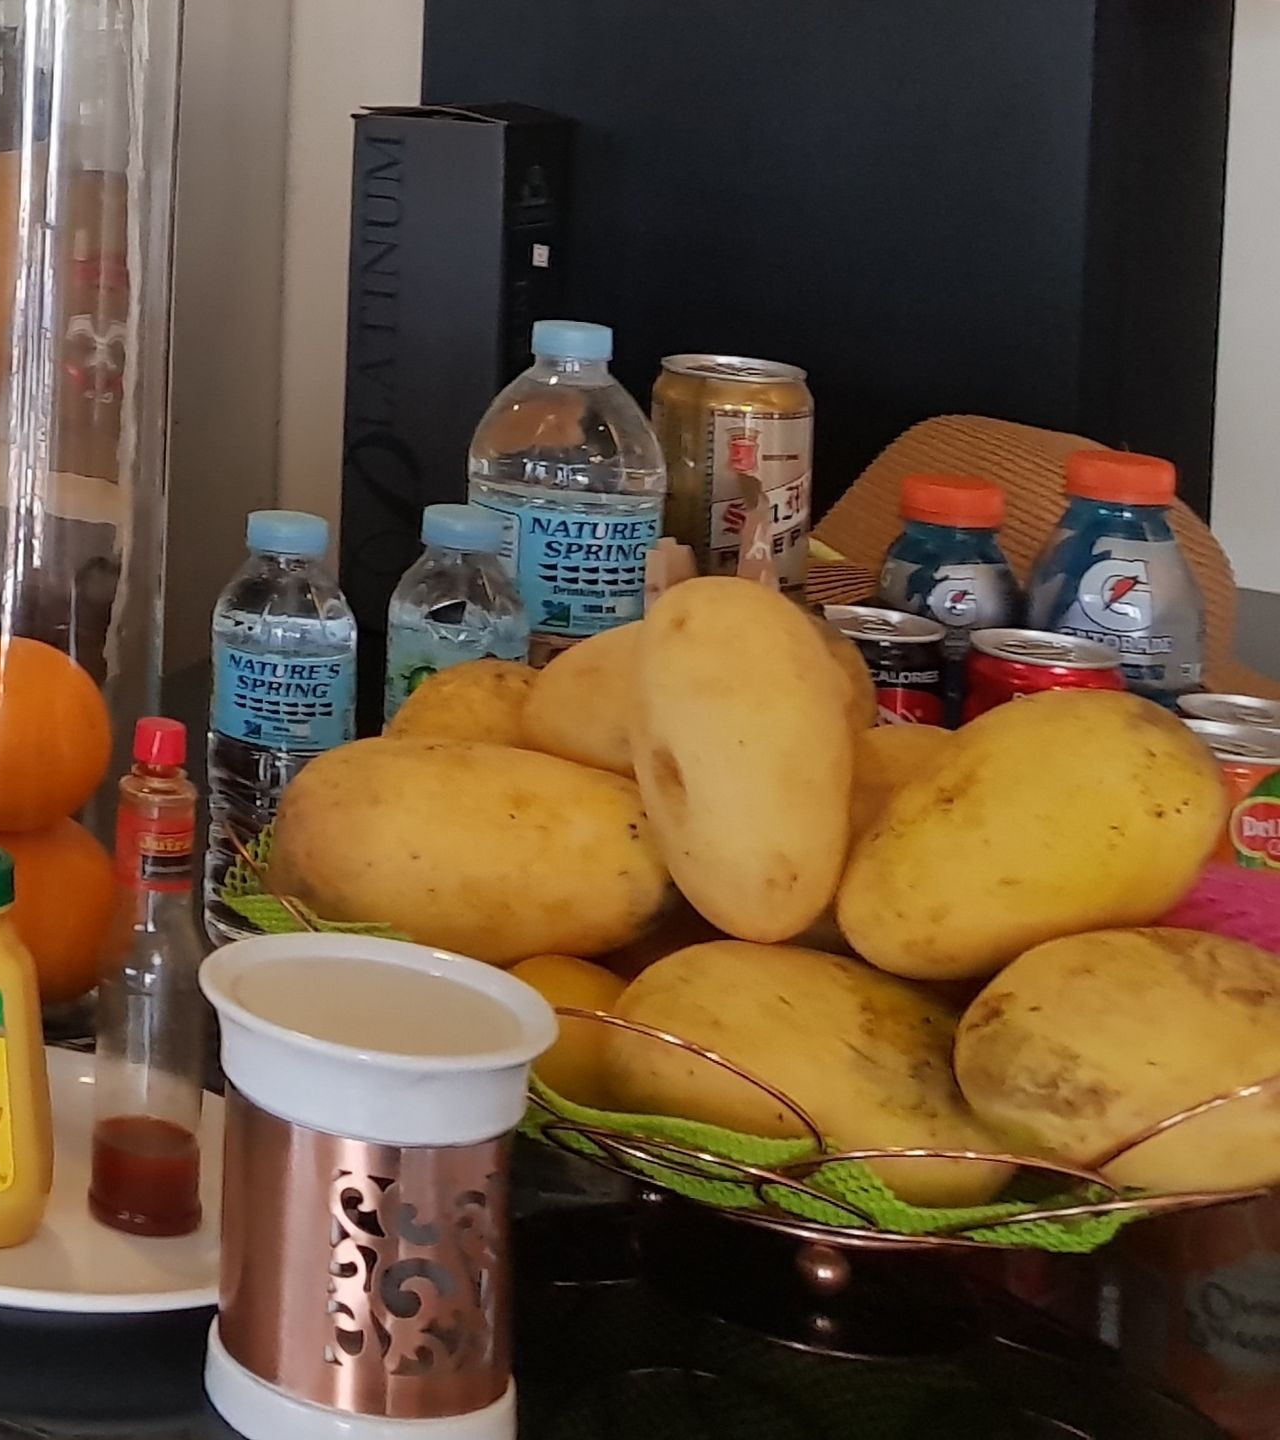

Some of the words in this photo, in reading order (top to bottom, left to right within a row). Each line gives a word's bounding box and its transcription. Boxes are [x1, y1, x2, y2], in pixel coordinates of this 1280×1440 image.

[529, 516, 657, 541] NATURE'S
[543, 539, 647, 563] SPRING
[228, 653, 342, 681] NATURE'S
[870, 668, 939, 685] CALORIES
[236, 674, 332, 699] SPRING
